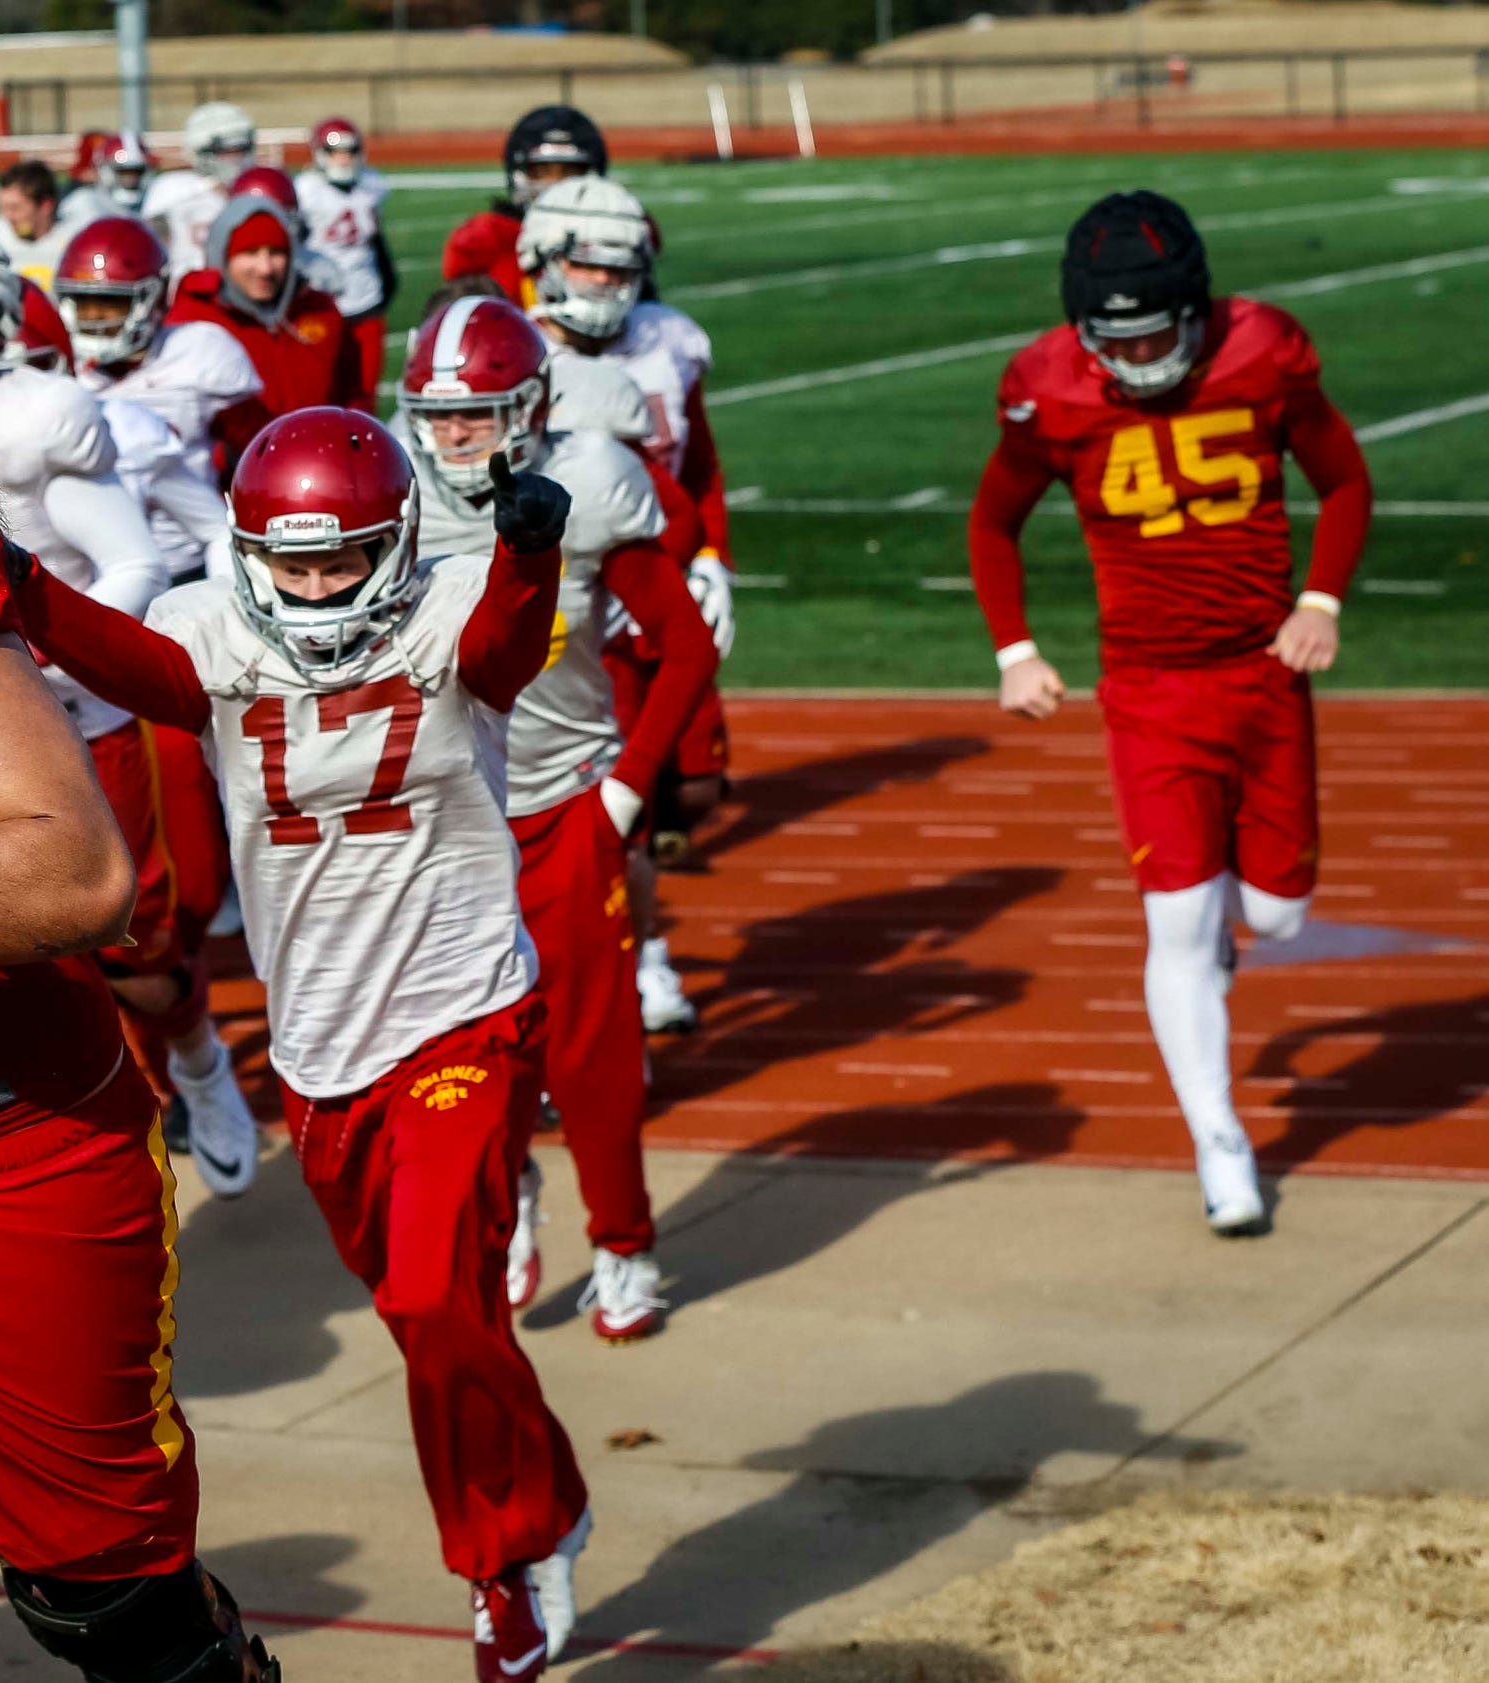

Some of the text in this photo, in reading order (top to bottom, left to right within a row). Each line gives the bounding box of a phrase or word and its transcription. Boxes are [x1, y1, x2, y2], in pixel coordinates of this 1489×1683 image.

[284, 518, 324, 530] Riddell
[1100, 407, 1262, 538] 45
[241, 672, 424, 845] 17
